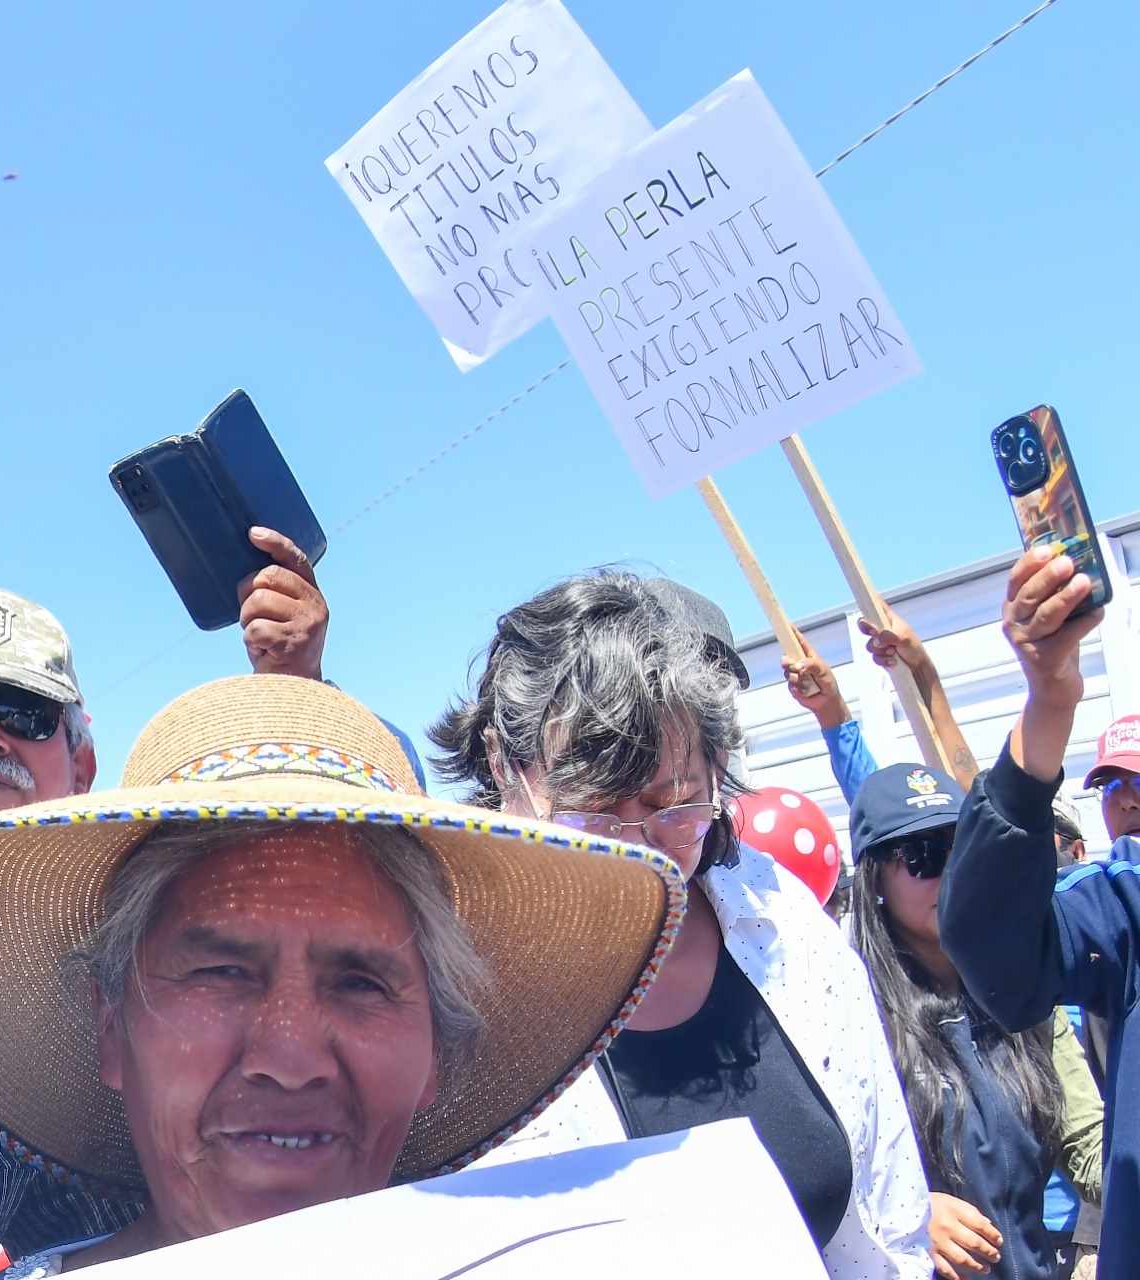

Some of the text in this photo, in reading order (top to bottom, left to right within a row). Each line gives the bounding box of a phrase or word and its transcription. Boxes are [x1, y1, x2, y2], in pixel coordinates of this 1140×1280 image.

[343, 34, 539, 203] ¡QUEREMOS
[389, 112, 537, 238] TITULOS
[425, 161, 561, 275] NO MÁS
[604, 151, 731, 252] PERLA
[578, 195, 798, 353] PRESENTE
[607, 262, 821, 401] EXIGIENDO
[634, 297, 903, 469] FORMALIZAR
